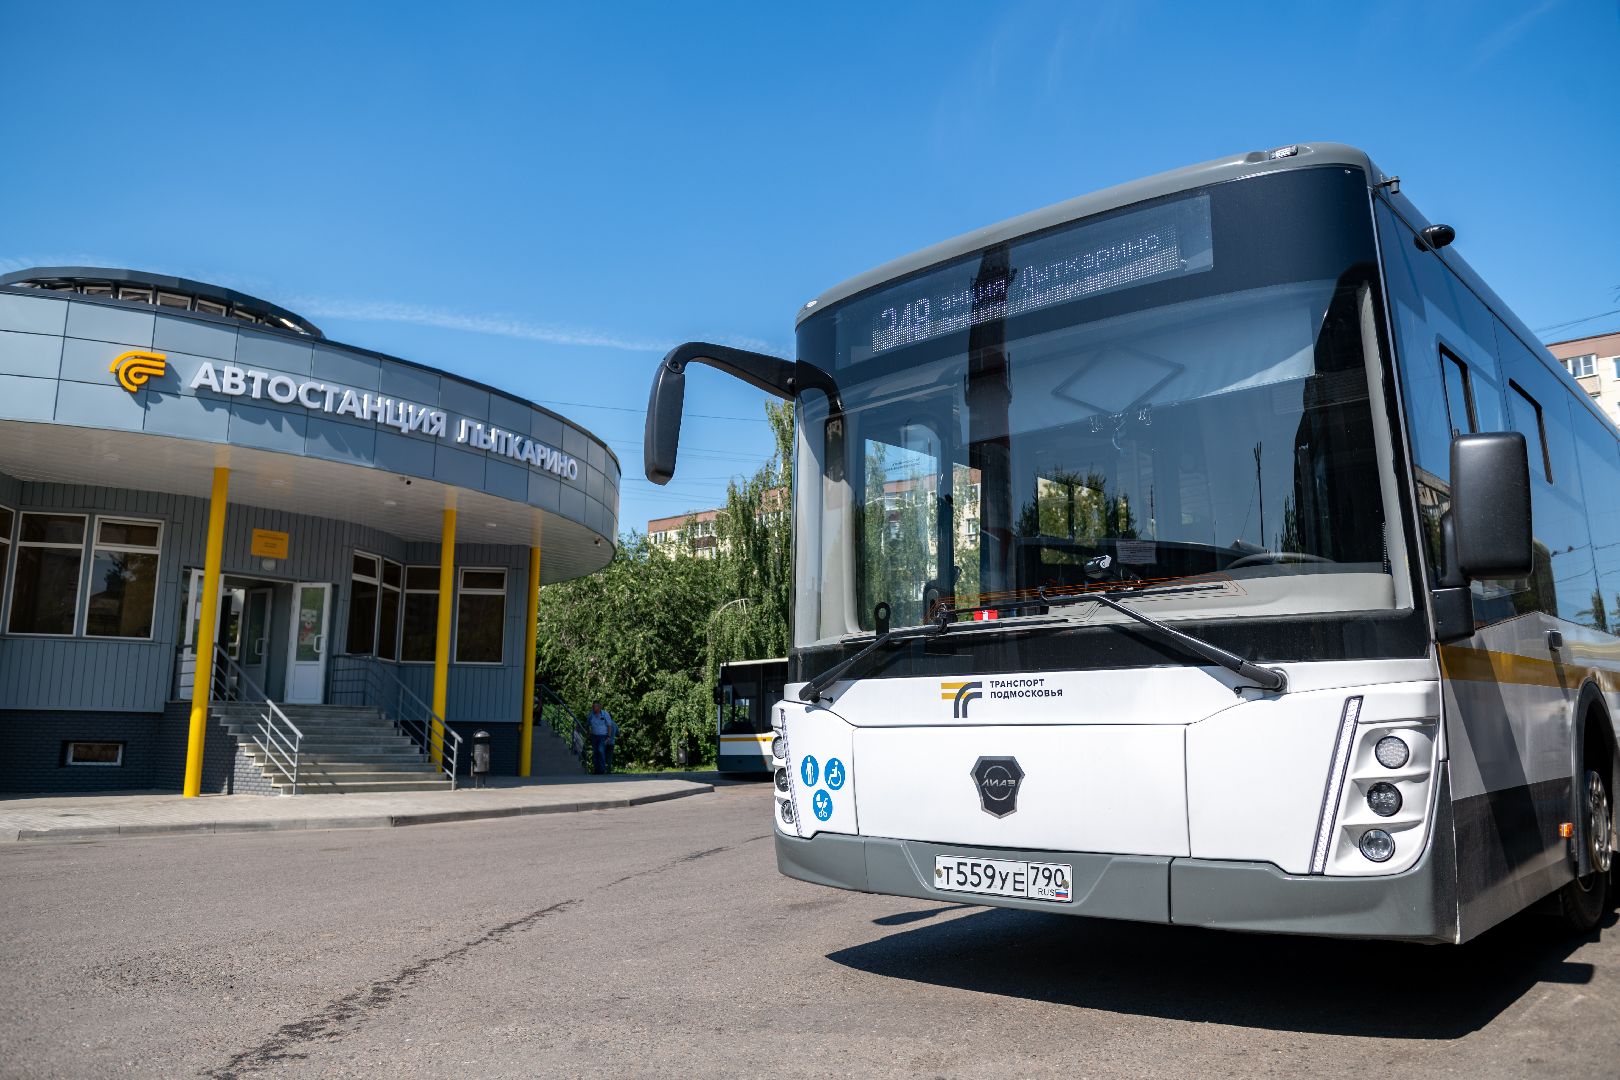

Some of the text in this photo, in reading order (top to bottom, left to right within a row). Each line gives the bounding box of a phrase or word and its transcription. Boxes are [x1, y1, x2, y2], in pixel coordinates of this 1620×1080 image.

[1021, 234, 1160, 288] Лыткарино
[190, 361, 578, 480] АВТОСТАНЦИЯ ЛЫТКАРИНО
[990, 679, 1045, 688] ТРАНСПОРТ
[990, 689, 1063, 699] ПОДМОСКОВЬЯ
[943, 862, 1066, 892] Т559УЕ 790
[1038, 888, 1055, 896] RUS
